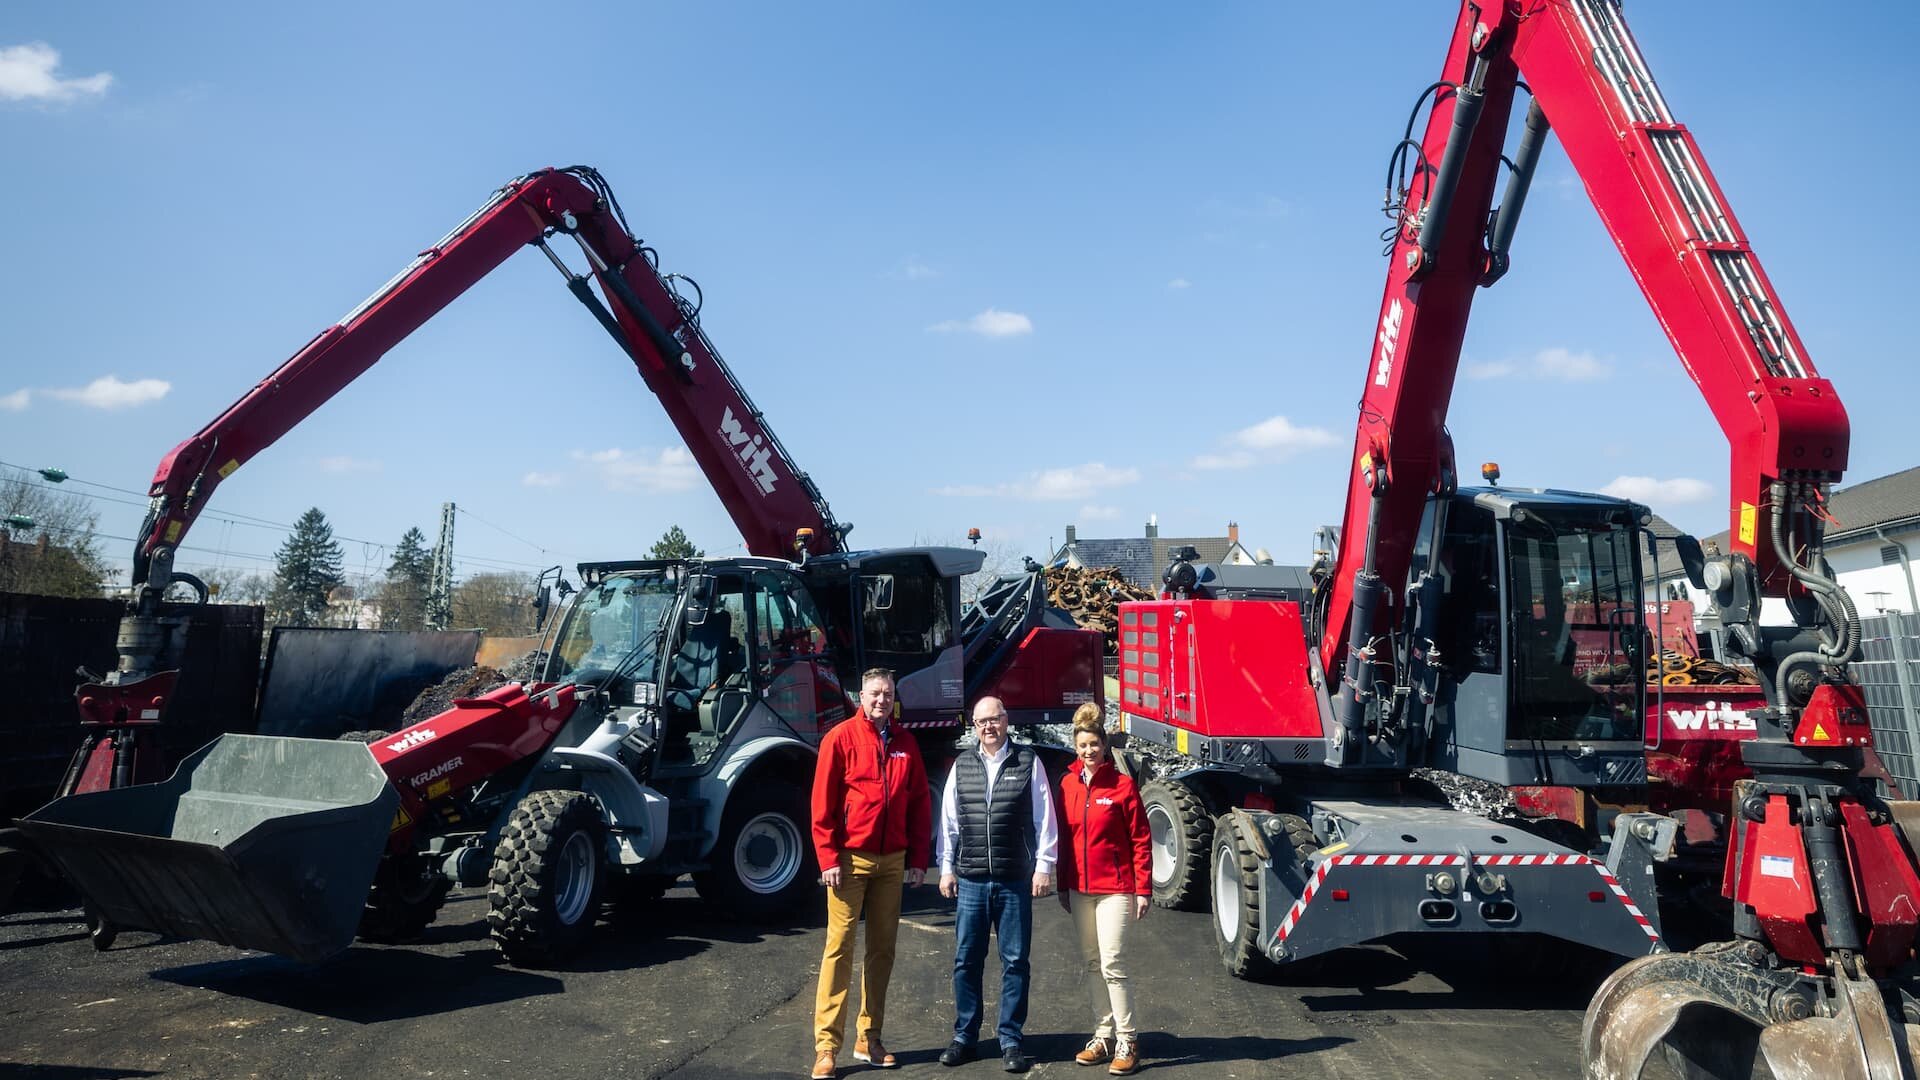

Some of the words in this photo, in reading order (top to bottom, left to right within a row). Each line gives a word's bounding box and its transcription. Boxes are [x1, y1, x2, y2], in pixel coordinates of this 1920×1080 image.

[1375, 298, 1402, 386] witz
[721, 405, 779, 494] witz
[1668, 701, 1757, 730] witz
[386, 728, 437, 752] witz
[411, 756, 464, 788] KRAMER
